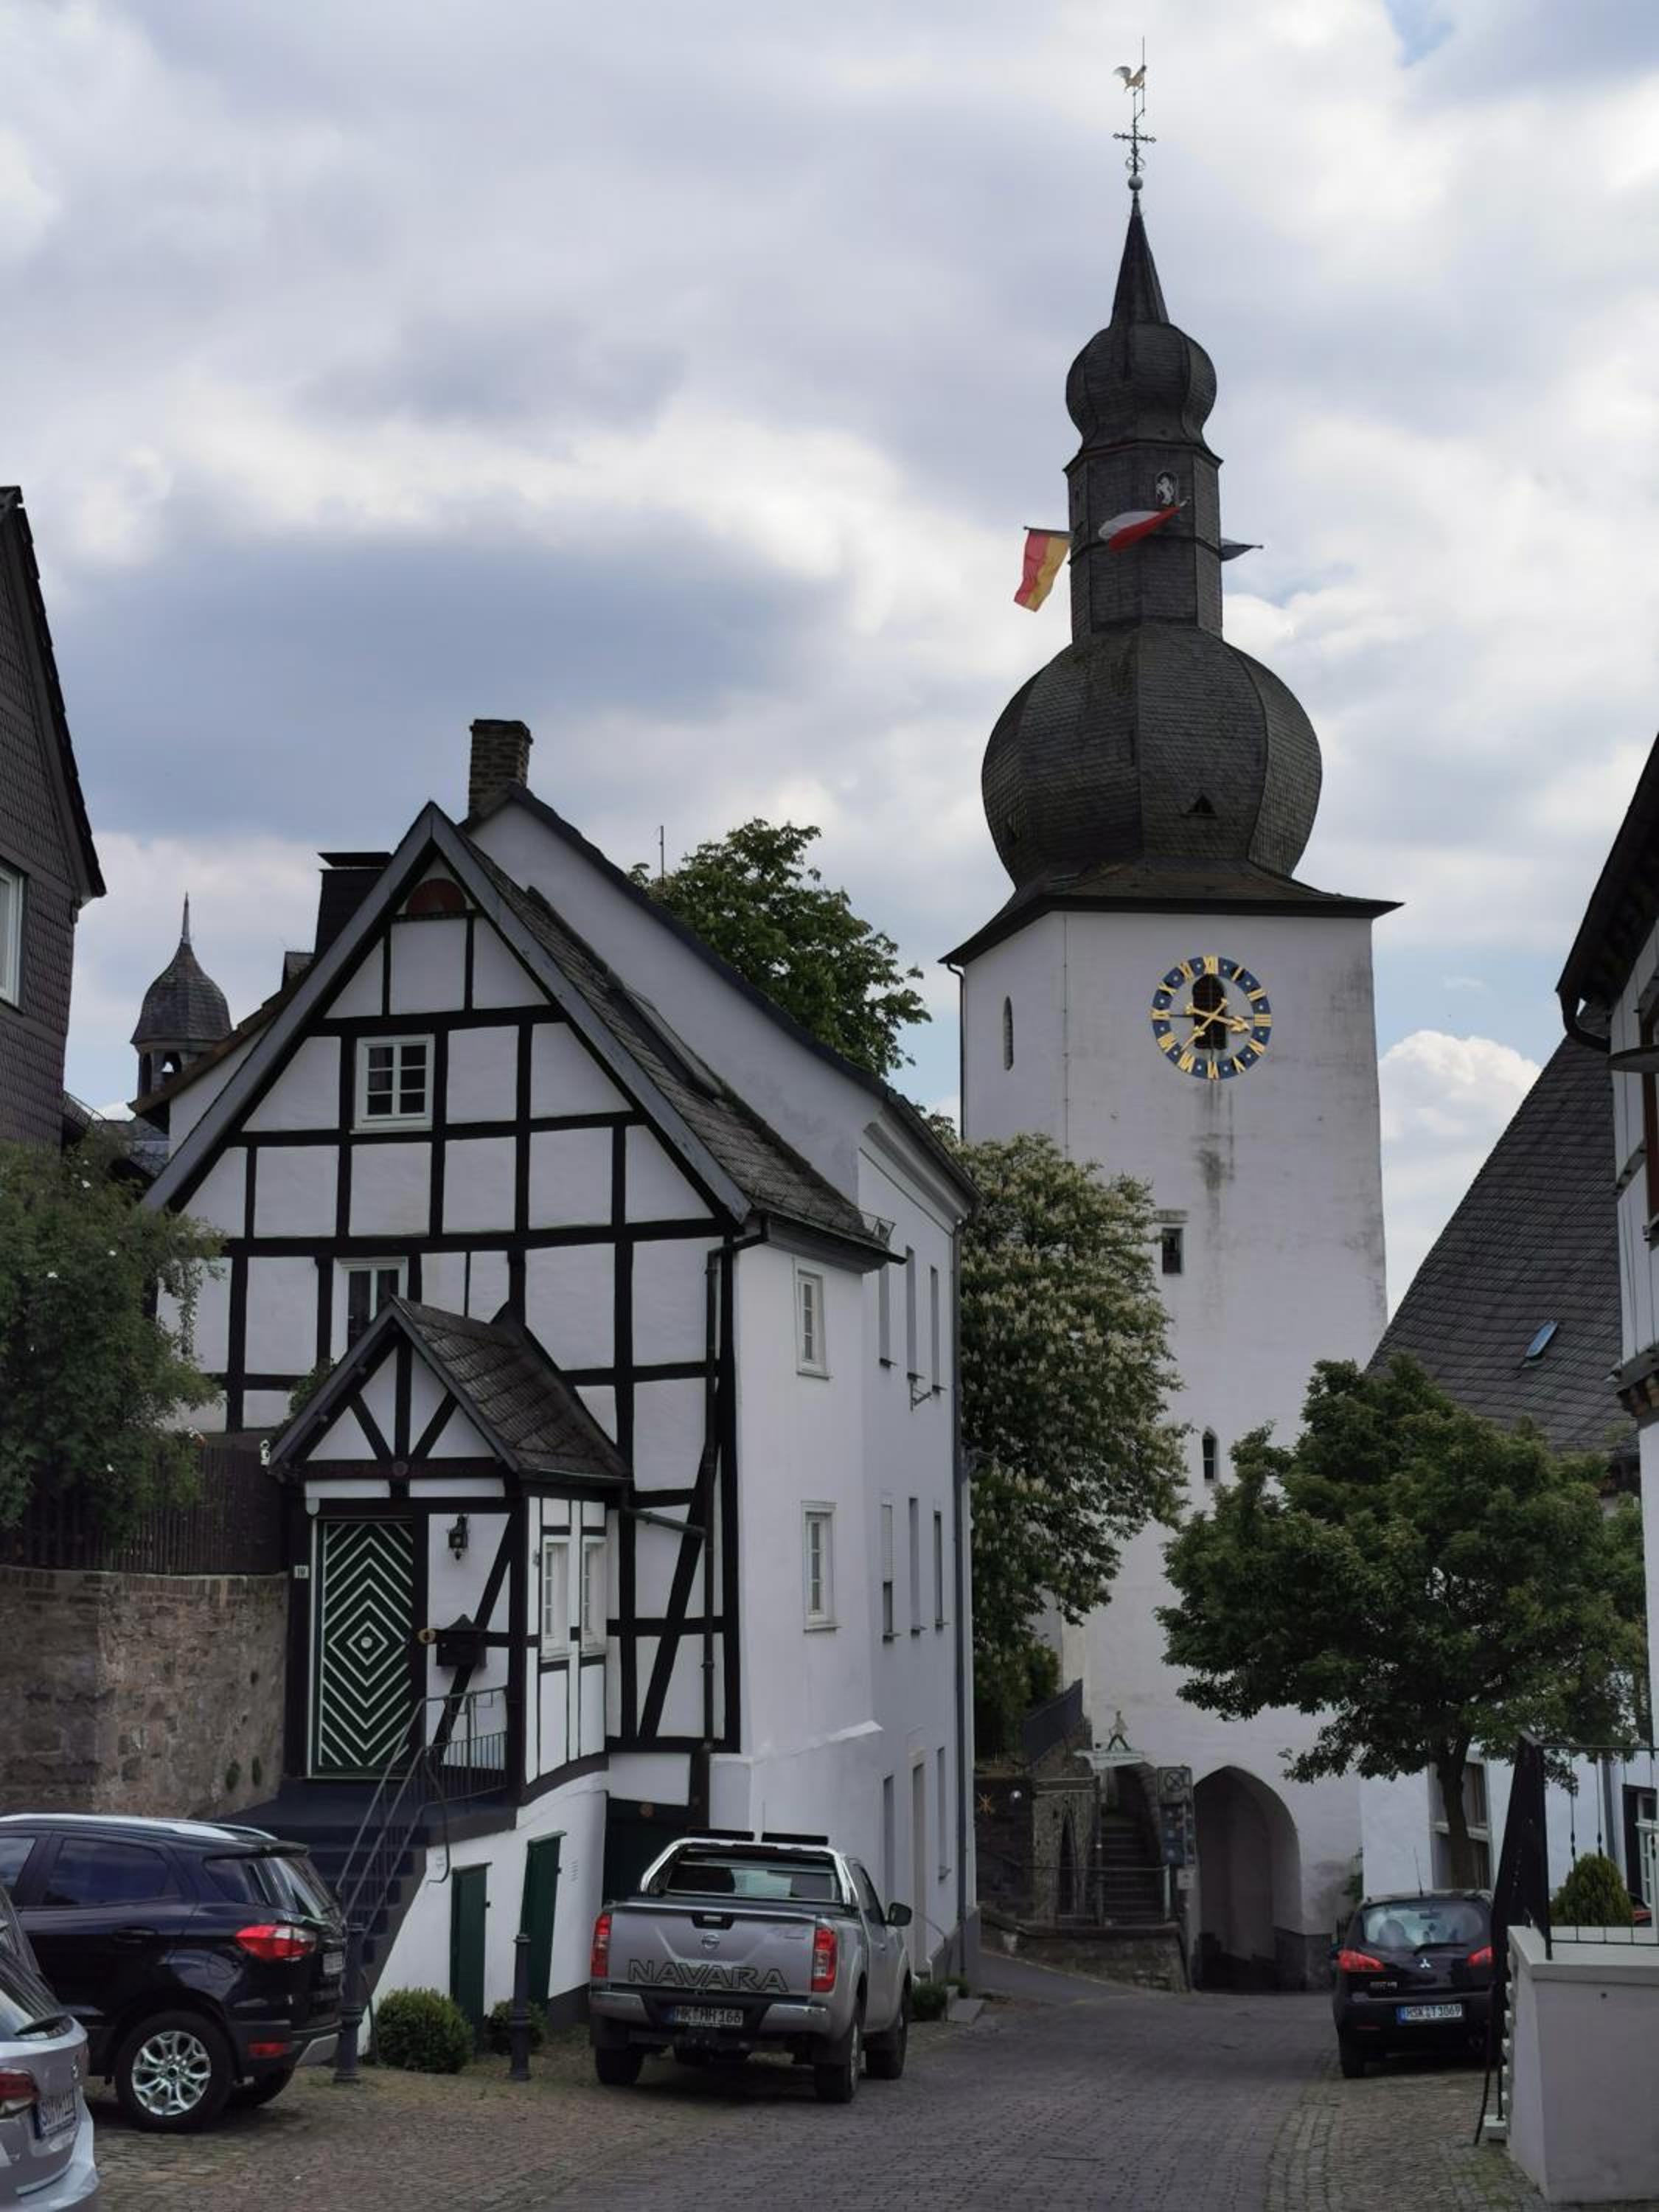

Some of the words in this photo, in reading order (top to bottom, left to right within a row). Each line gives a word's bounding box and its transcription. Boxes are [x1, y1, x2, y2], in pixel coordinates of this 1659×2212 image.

[1232, 967, 1243, 981] I
[1158, 982, 1178, 995] X
[1247, 989, 1266, 1001] II
[1150, 1009, 1170, 1020] IX
[1254, 1014, 1272, 1026] III
[1207, 1062, 1220, 1079] VI
[1232, 1057, 1246, 1074] V
[628, 1958, 789, 1993] NAVARA
